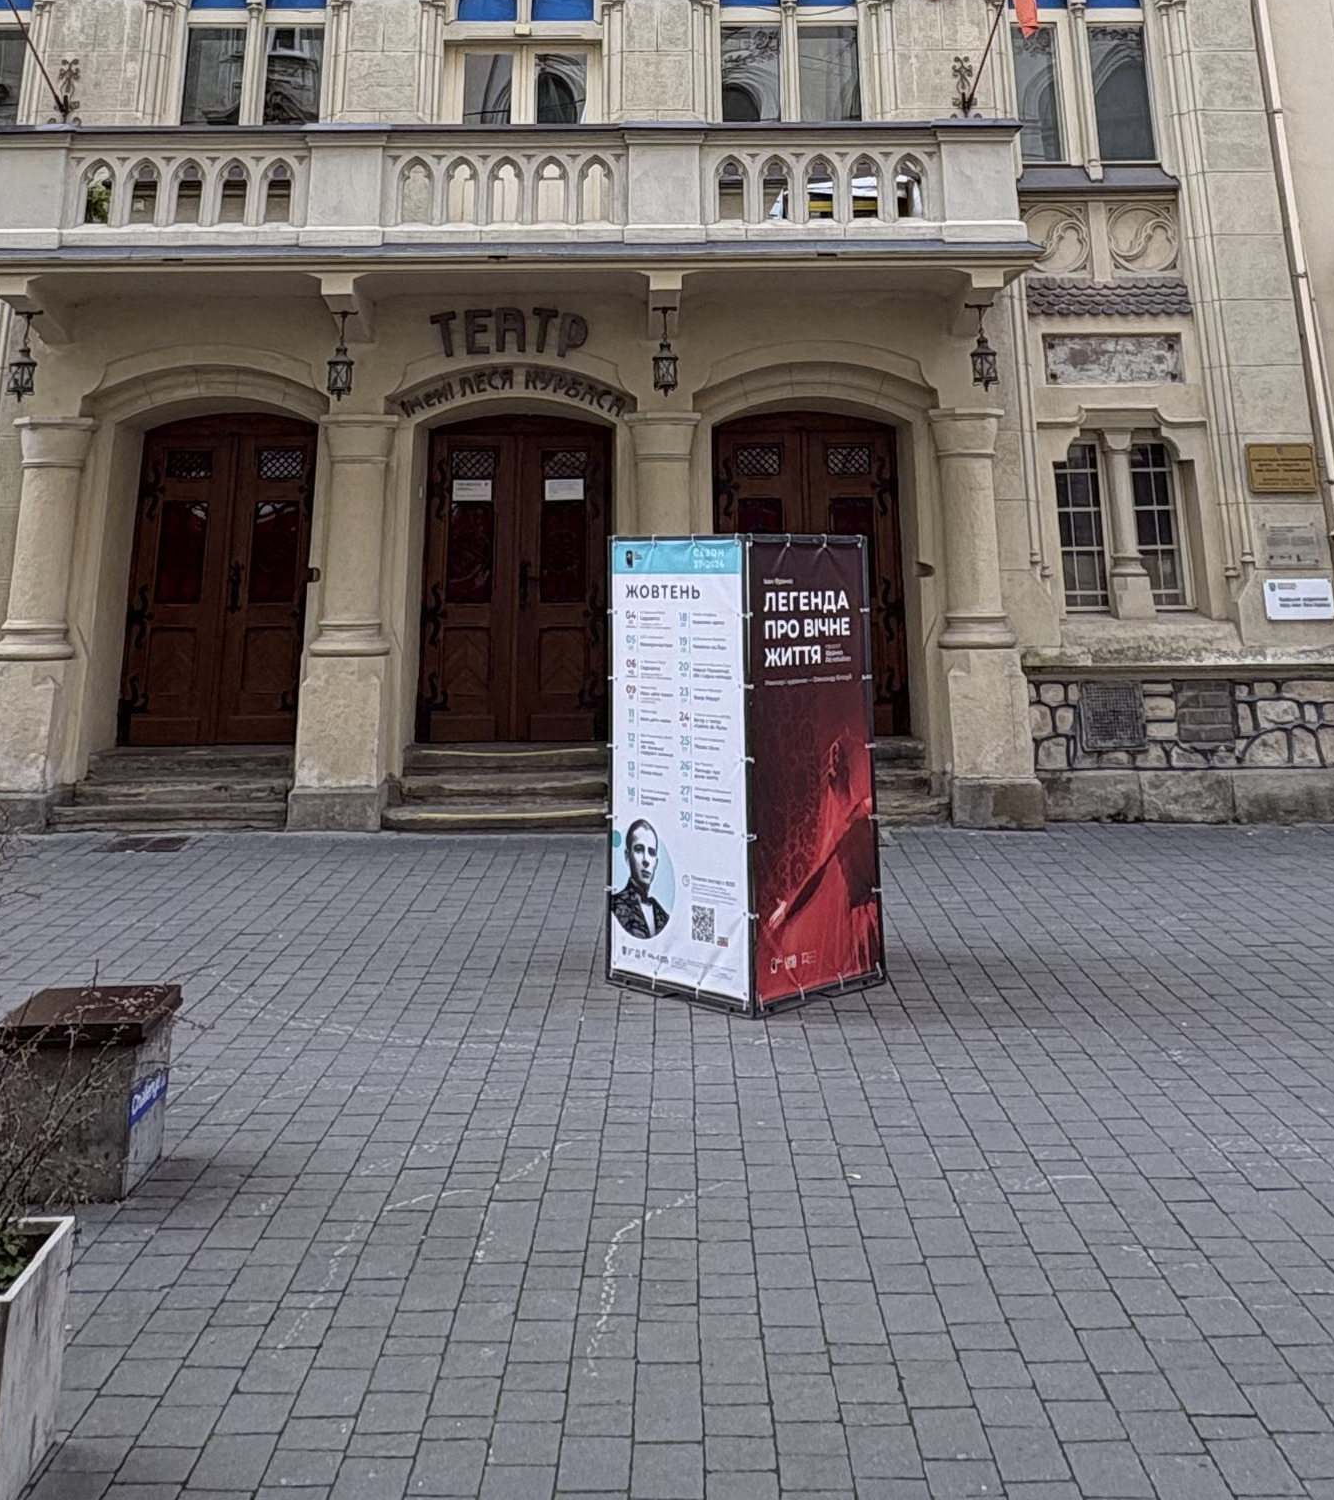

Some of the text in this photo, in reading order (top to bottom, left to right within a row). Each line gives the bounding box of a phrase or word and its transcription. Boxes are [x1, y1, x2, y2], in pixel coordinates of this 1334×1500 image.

[429, 306, 589, 358] ТЕАТР
[459, 368, 514, 398] ЛЕСЯ
[524, 367, 626, 418] КУРБАСА
[625, 583, 701, 600] ЖОВТЕНЬ
[763, 590, 850, 614] ЛЕГЕНДА
[764, 616, 851, 640] ПРО ВІЧНЕ
[764, 645, 821, 668] ЖИТТЯ
